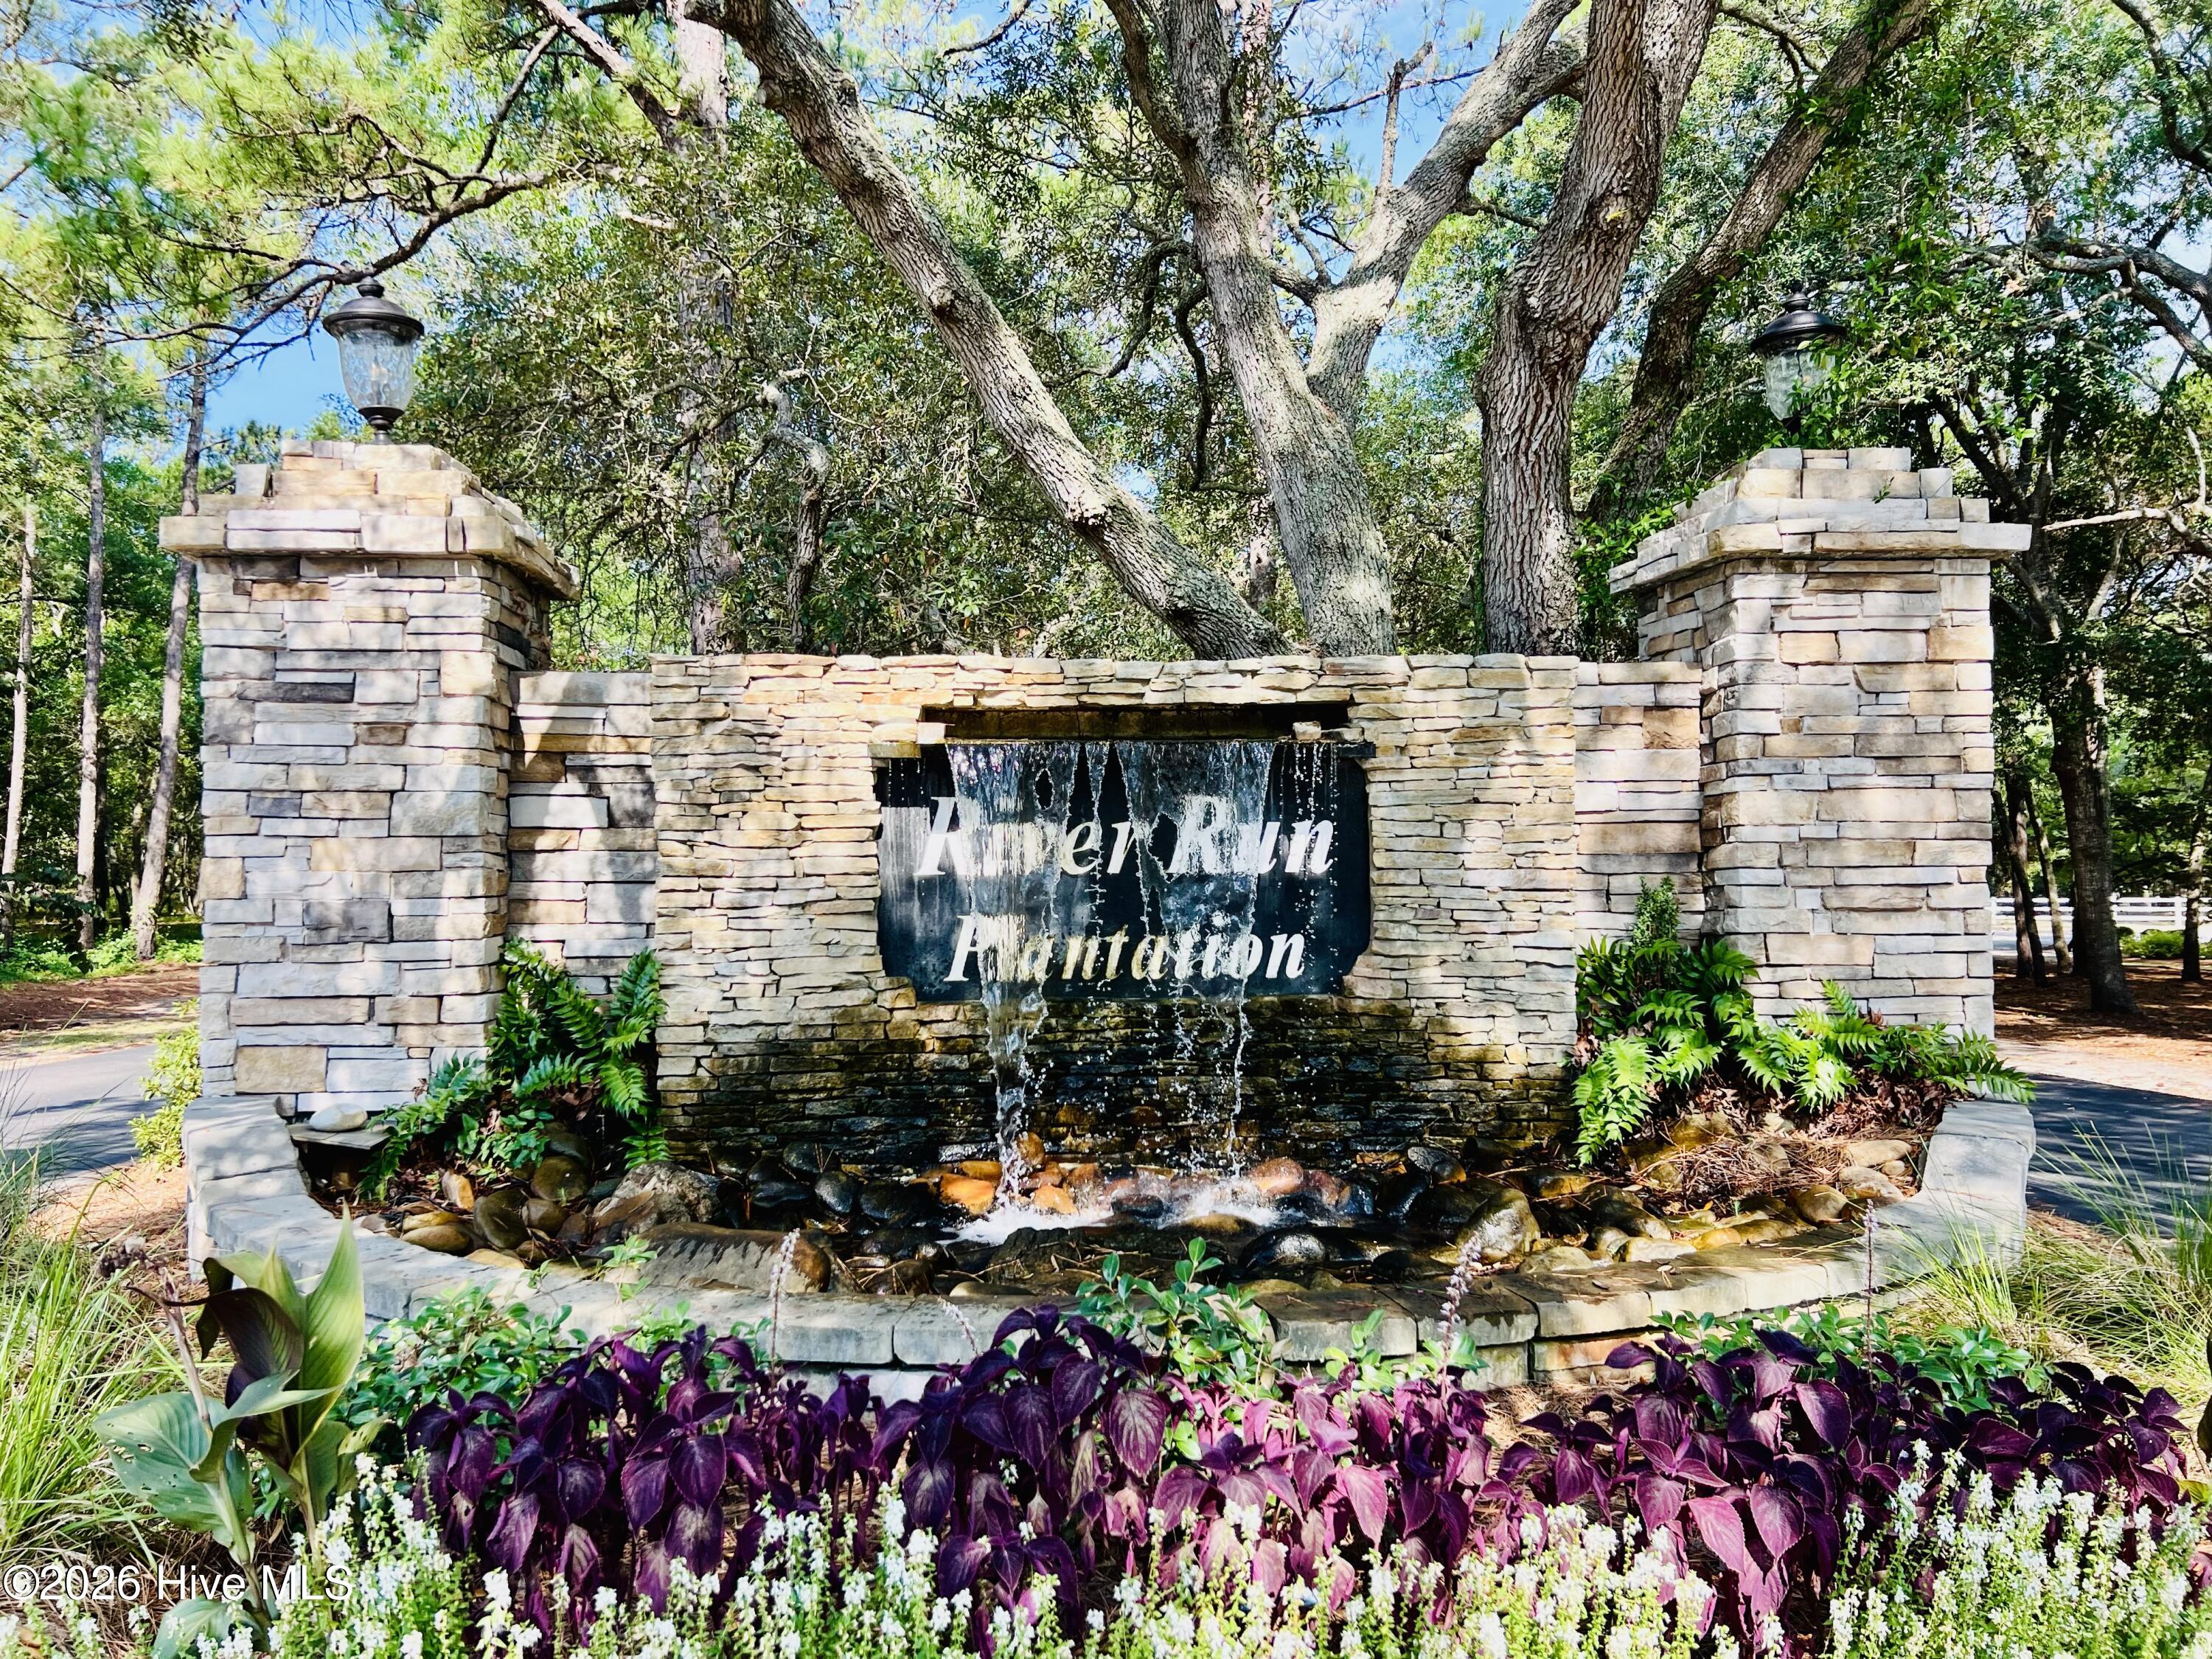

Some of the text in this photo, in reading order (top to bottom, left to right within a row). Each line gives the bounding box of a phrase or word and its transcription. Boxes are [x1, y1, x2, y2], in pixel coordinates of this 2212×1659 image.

[914, 794, 1334, 876] Rer Run
[943, 914, 1304, 981] Pantation
